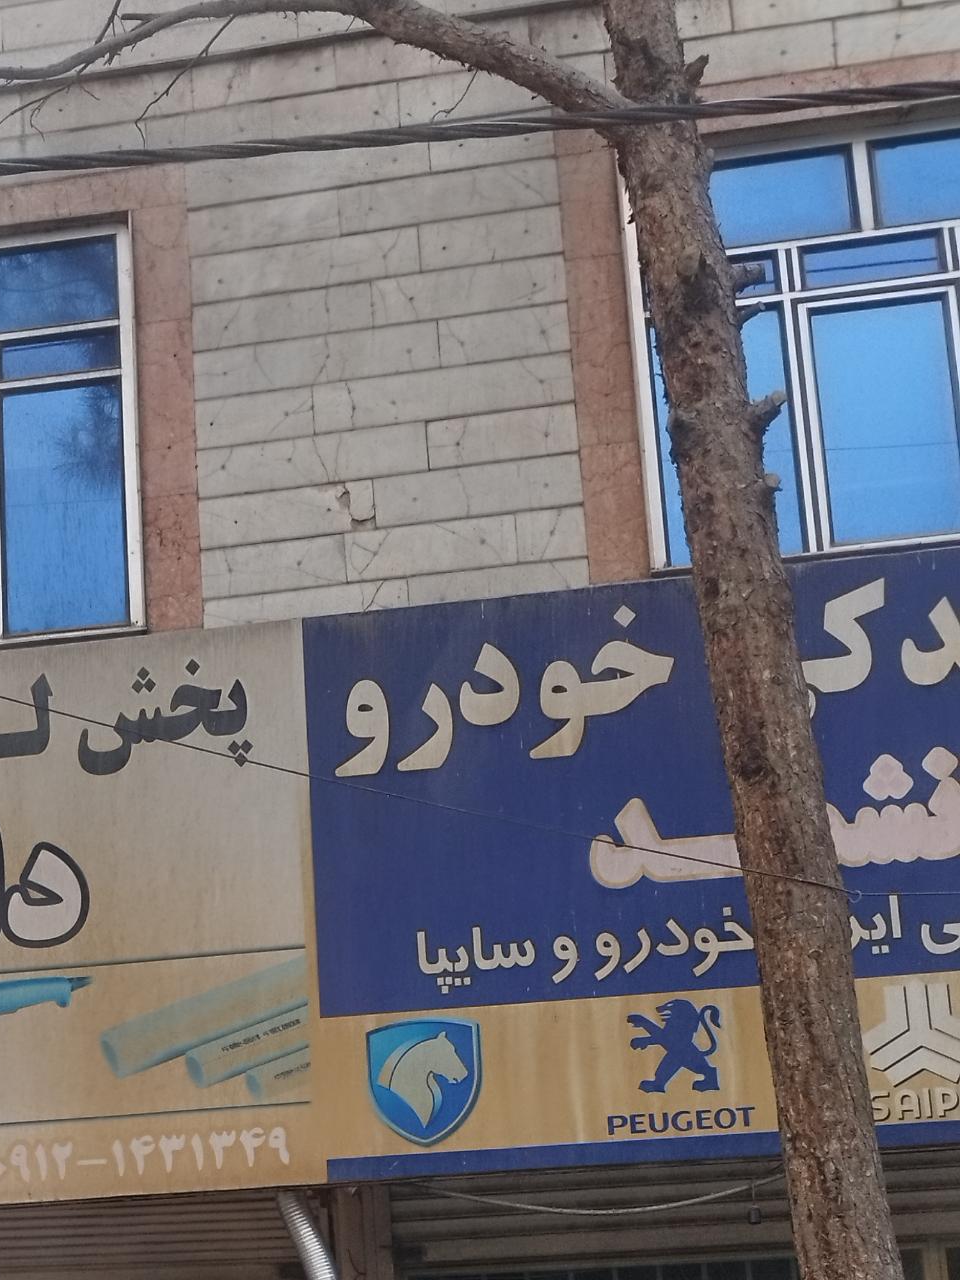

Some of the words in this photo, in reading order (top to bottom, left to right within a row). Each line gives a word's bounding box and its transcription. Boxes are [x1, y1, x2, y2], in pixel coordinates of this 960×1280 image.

[77, 658, 251, 776] پخش
[335, 604, 674, 777] خودرو
[417, 926, 537, 995] سایپا
[551, 934, 580, 985] و
[595, 906, 755, 983] خودرو
[607, 1106, 756, 1137] PEUGEOT
